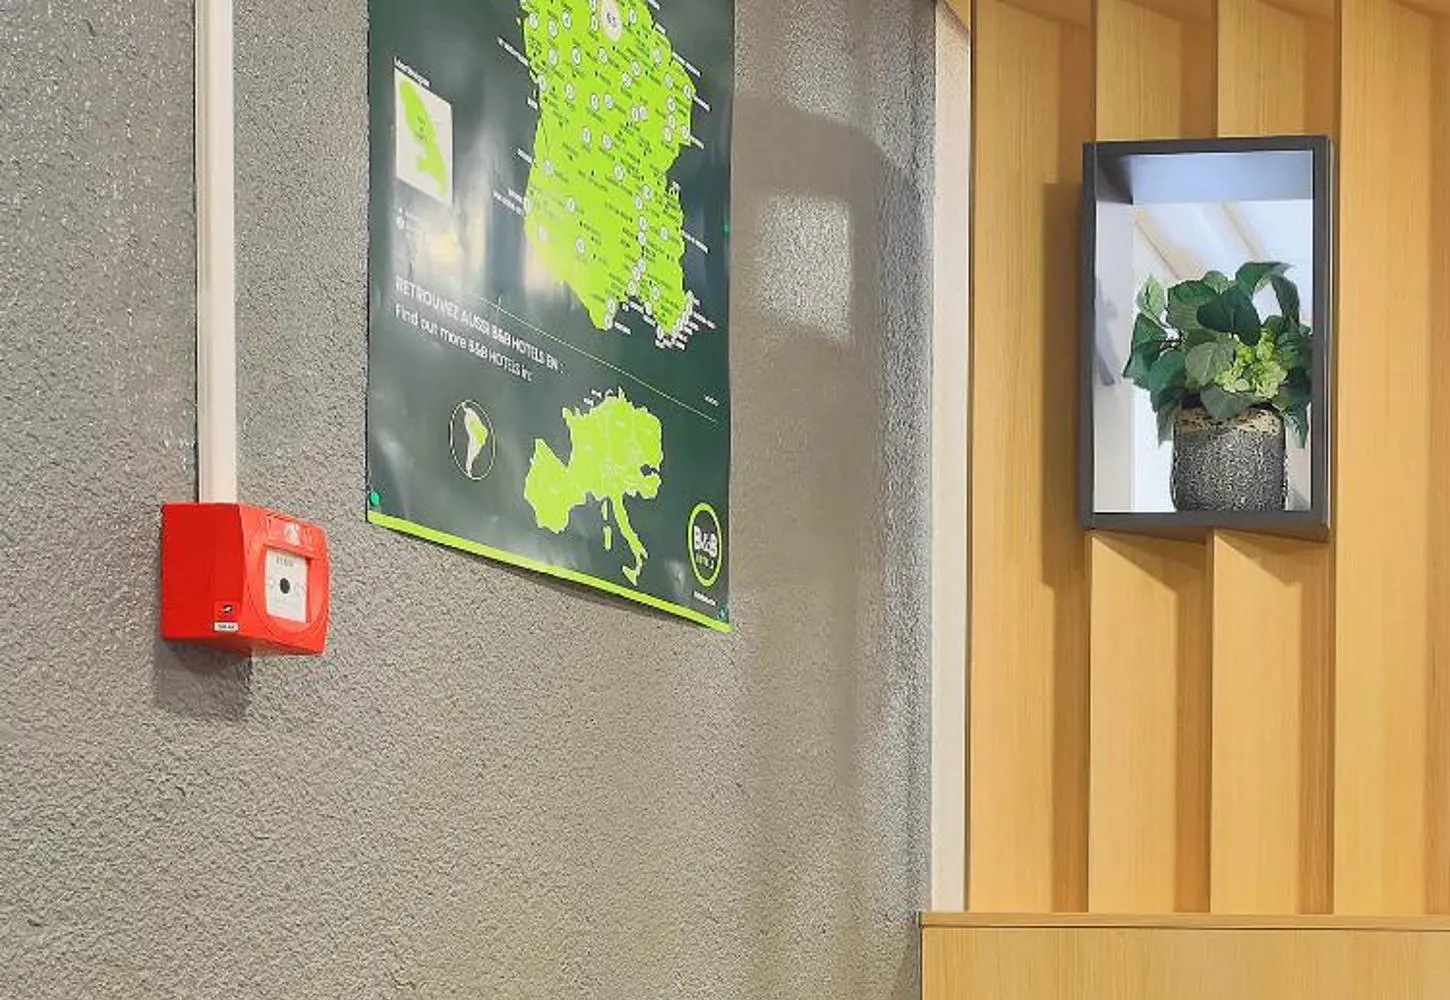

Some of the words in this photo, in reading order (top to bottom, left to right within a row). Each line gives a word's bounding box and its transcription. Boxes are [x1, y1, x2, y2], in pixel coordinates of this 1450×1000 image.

[395, 275, 459, 320] RETROUVEZ
[512, 336, 545, 364] HOTELS
[396, 303, 418, 325] Find
[421, 319, 437, 334] out
[441, 328, 466, 348] more
[489, 349, 521, 375] HOTELS
[694, 525, 718, 558] B&B
